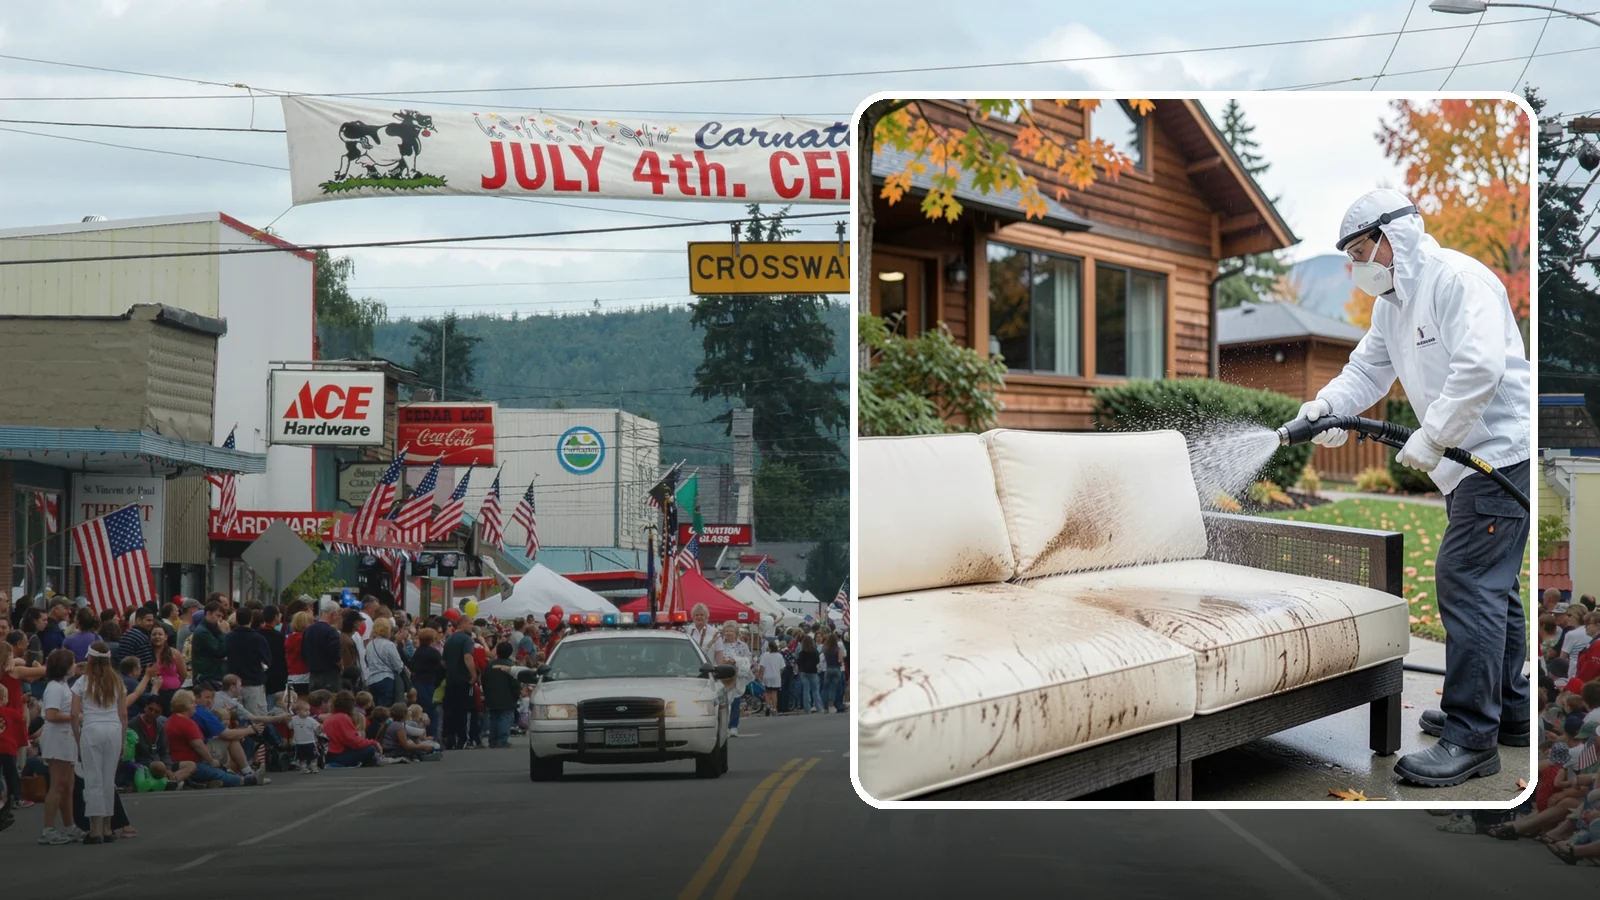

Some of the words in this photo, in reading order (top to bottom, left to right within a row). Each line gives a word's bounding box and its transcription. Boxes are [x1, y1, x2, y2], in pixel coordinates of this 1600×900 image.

[481, 141, 605, 192] JULY
[632, 150, 746, 197] 4th.
[697, 254, 850, 280] CROSSWA
[282, 380, 373, 419] ACE
[405, 409, 452, 422] CEDAR
[461, 409, 485, 422] LOG
[283, 421, 371, 436] Hardware
[416, 428, 477, 447] Coca-Cola
[353, 467, 386, 480] Simpl
[83, 485, 93, 494] St.
[95, 485, 124, 494] Vincent
[126, 486, 135, 494] de
[137, 486, 155, 495] Paul
[81, 503, 154, 522] THT
[688, 526, 741, 535] CRNATION
[699, 535, 730, 543] GLASS
